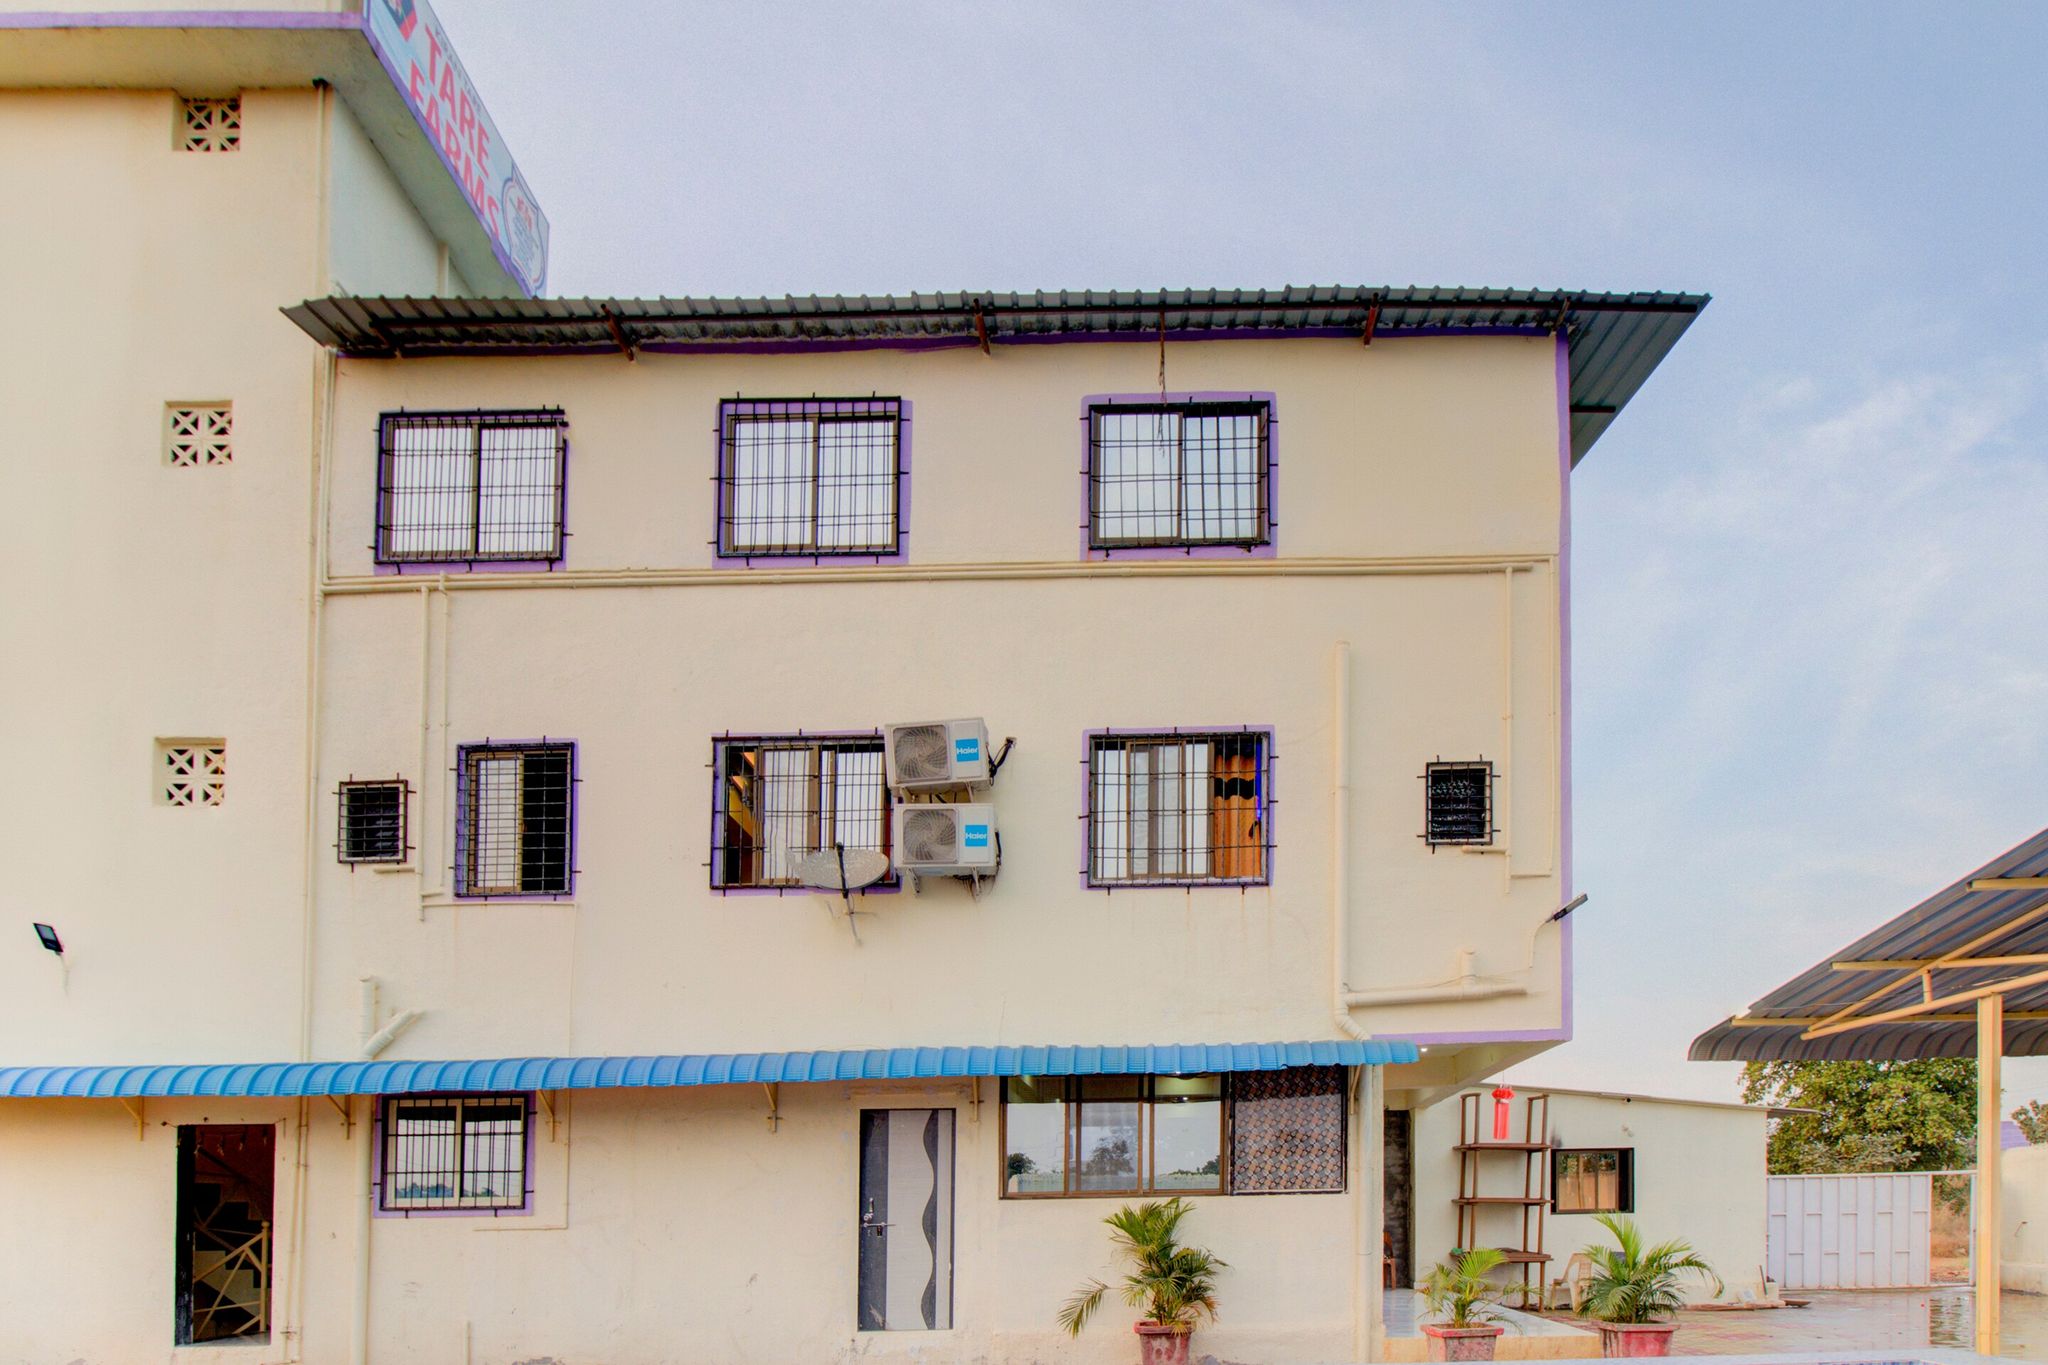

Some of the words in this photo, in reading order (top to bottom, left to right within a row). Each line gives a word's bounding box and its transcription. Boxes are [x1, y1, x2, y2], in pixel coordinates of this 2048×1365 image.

[425, 23, 490, 180] TARE
[410, 58, 500, 241] FARMS
[956, 746, 978, 755] Haier
[965, 832, 987, 840] Haier
